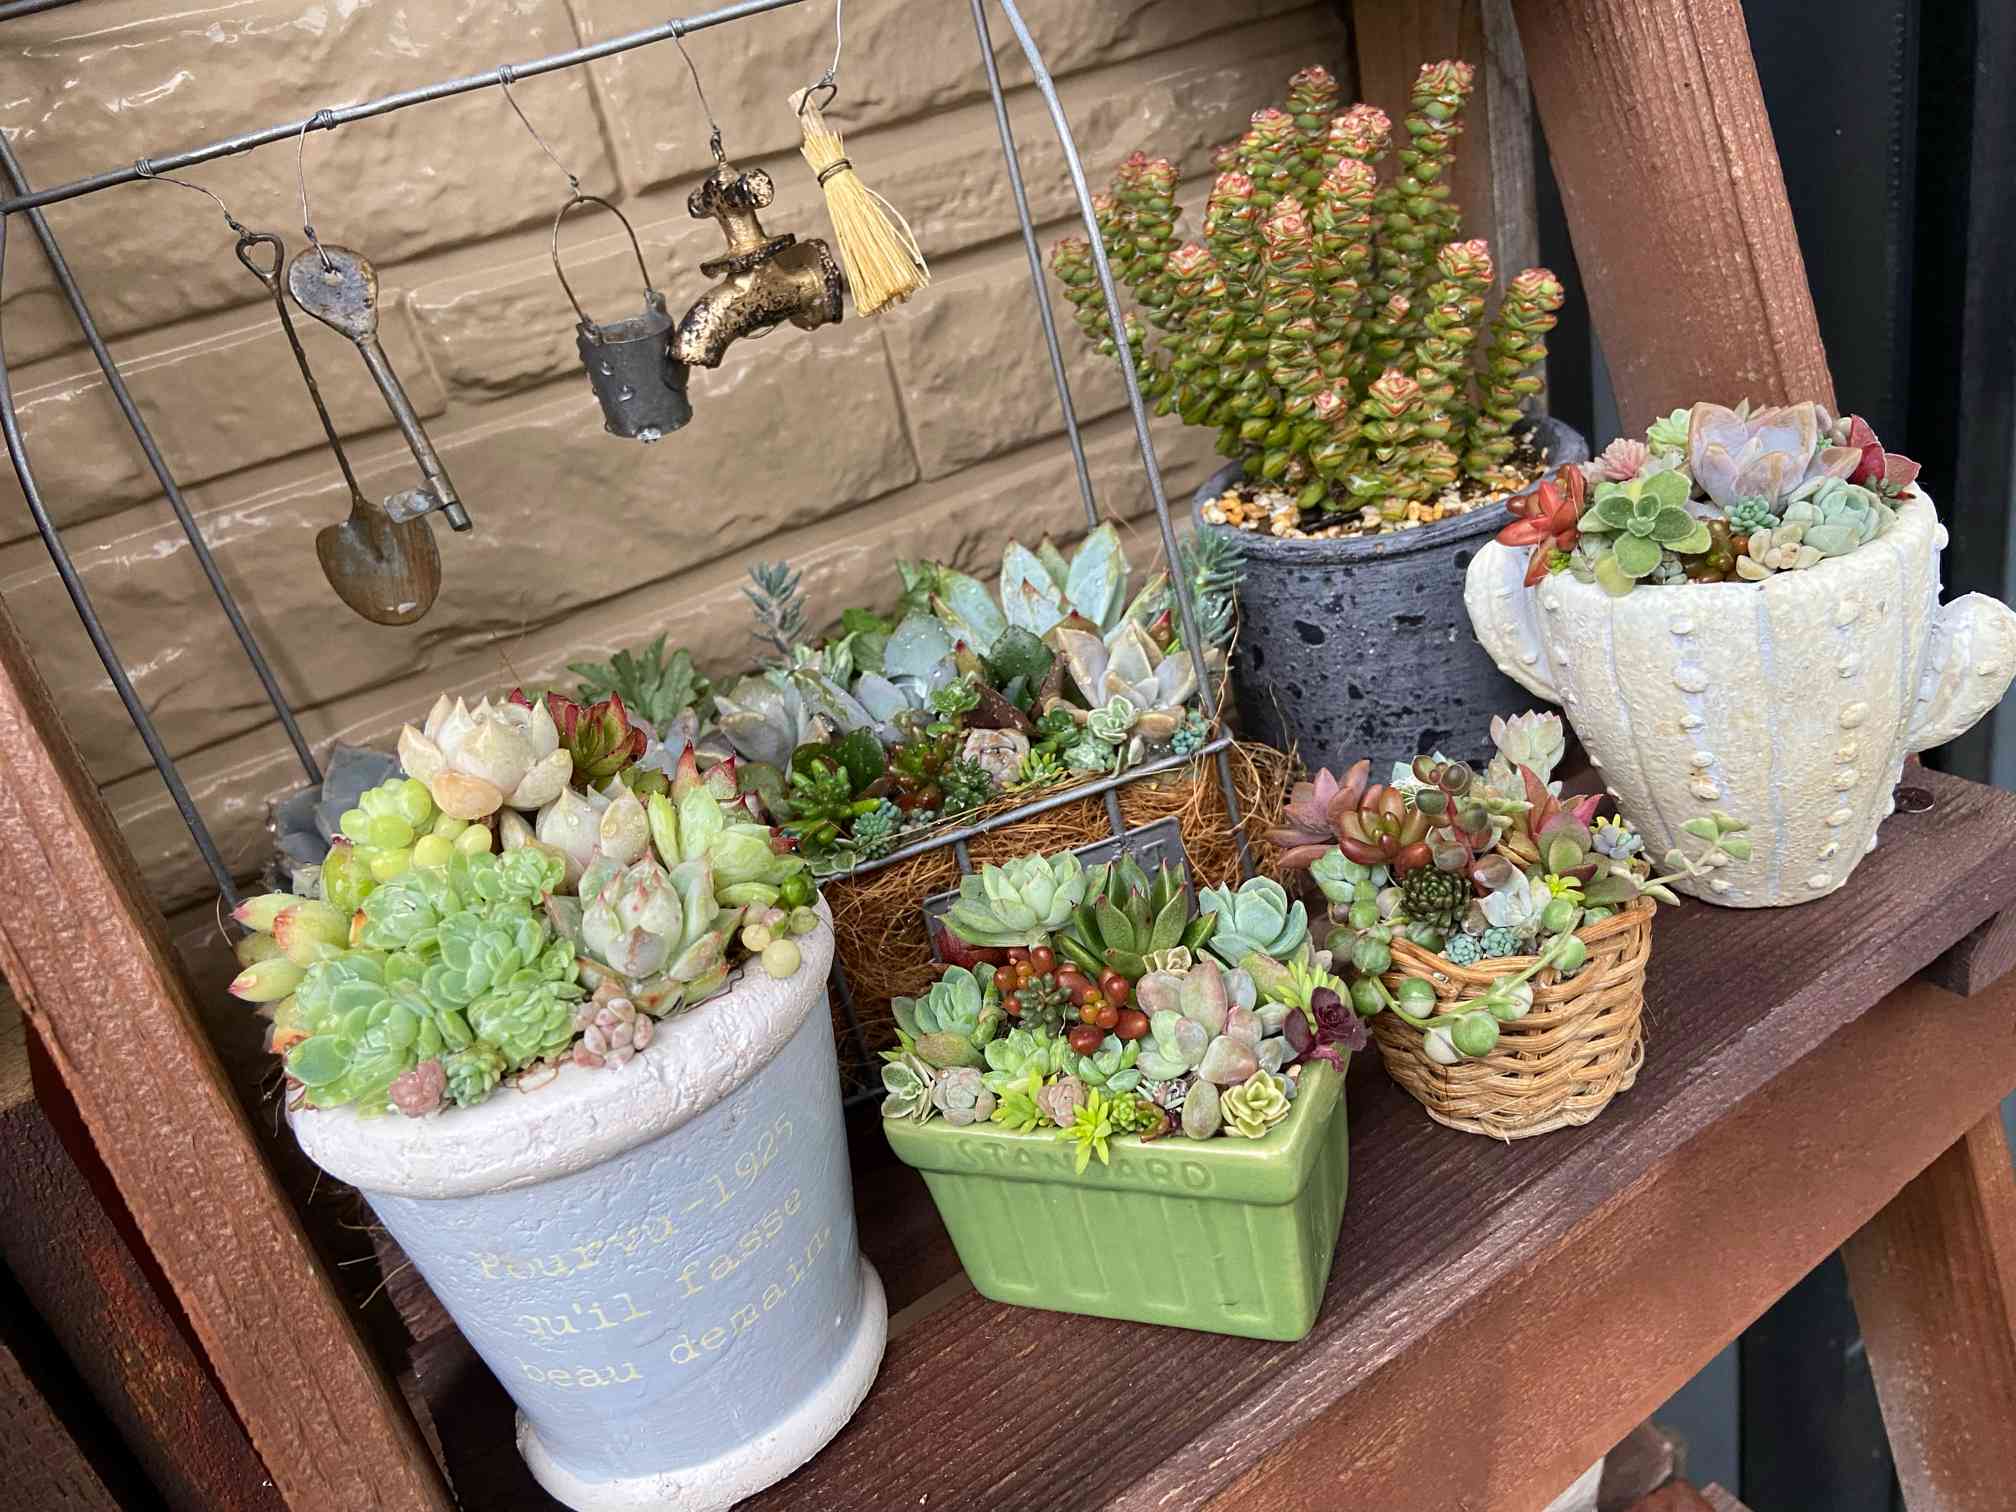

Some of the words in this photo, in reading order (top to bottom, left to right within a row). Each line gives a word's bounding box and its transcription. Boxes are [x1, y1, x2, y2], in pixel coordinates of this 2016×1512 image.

[956, 1138, 1216, 1192] STANARD
[676, 1188, 801, 1298] fasse
[515, 1356, 643, 1387] beau
[671, 1226, 832, 1364] demain
